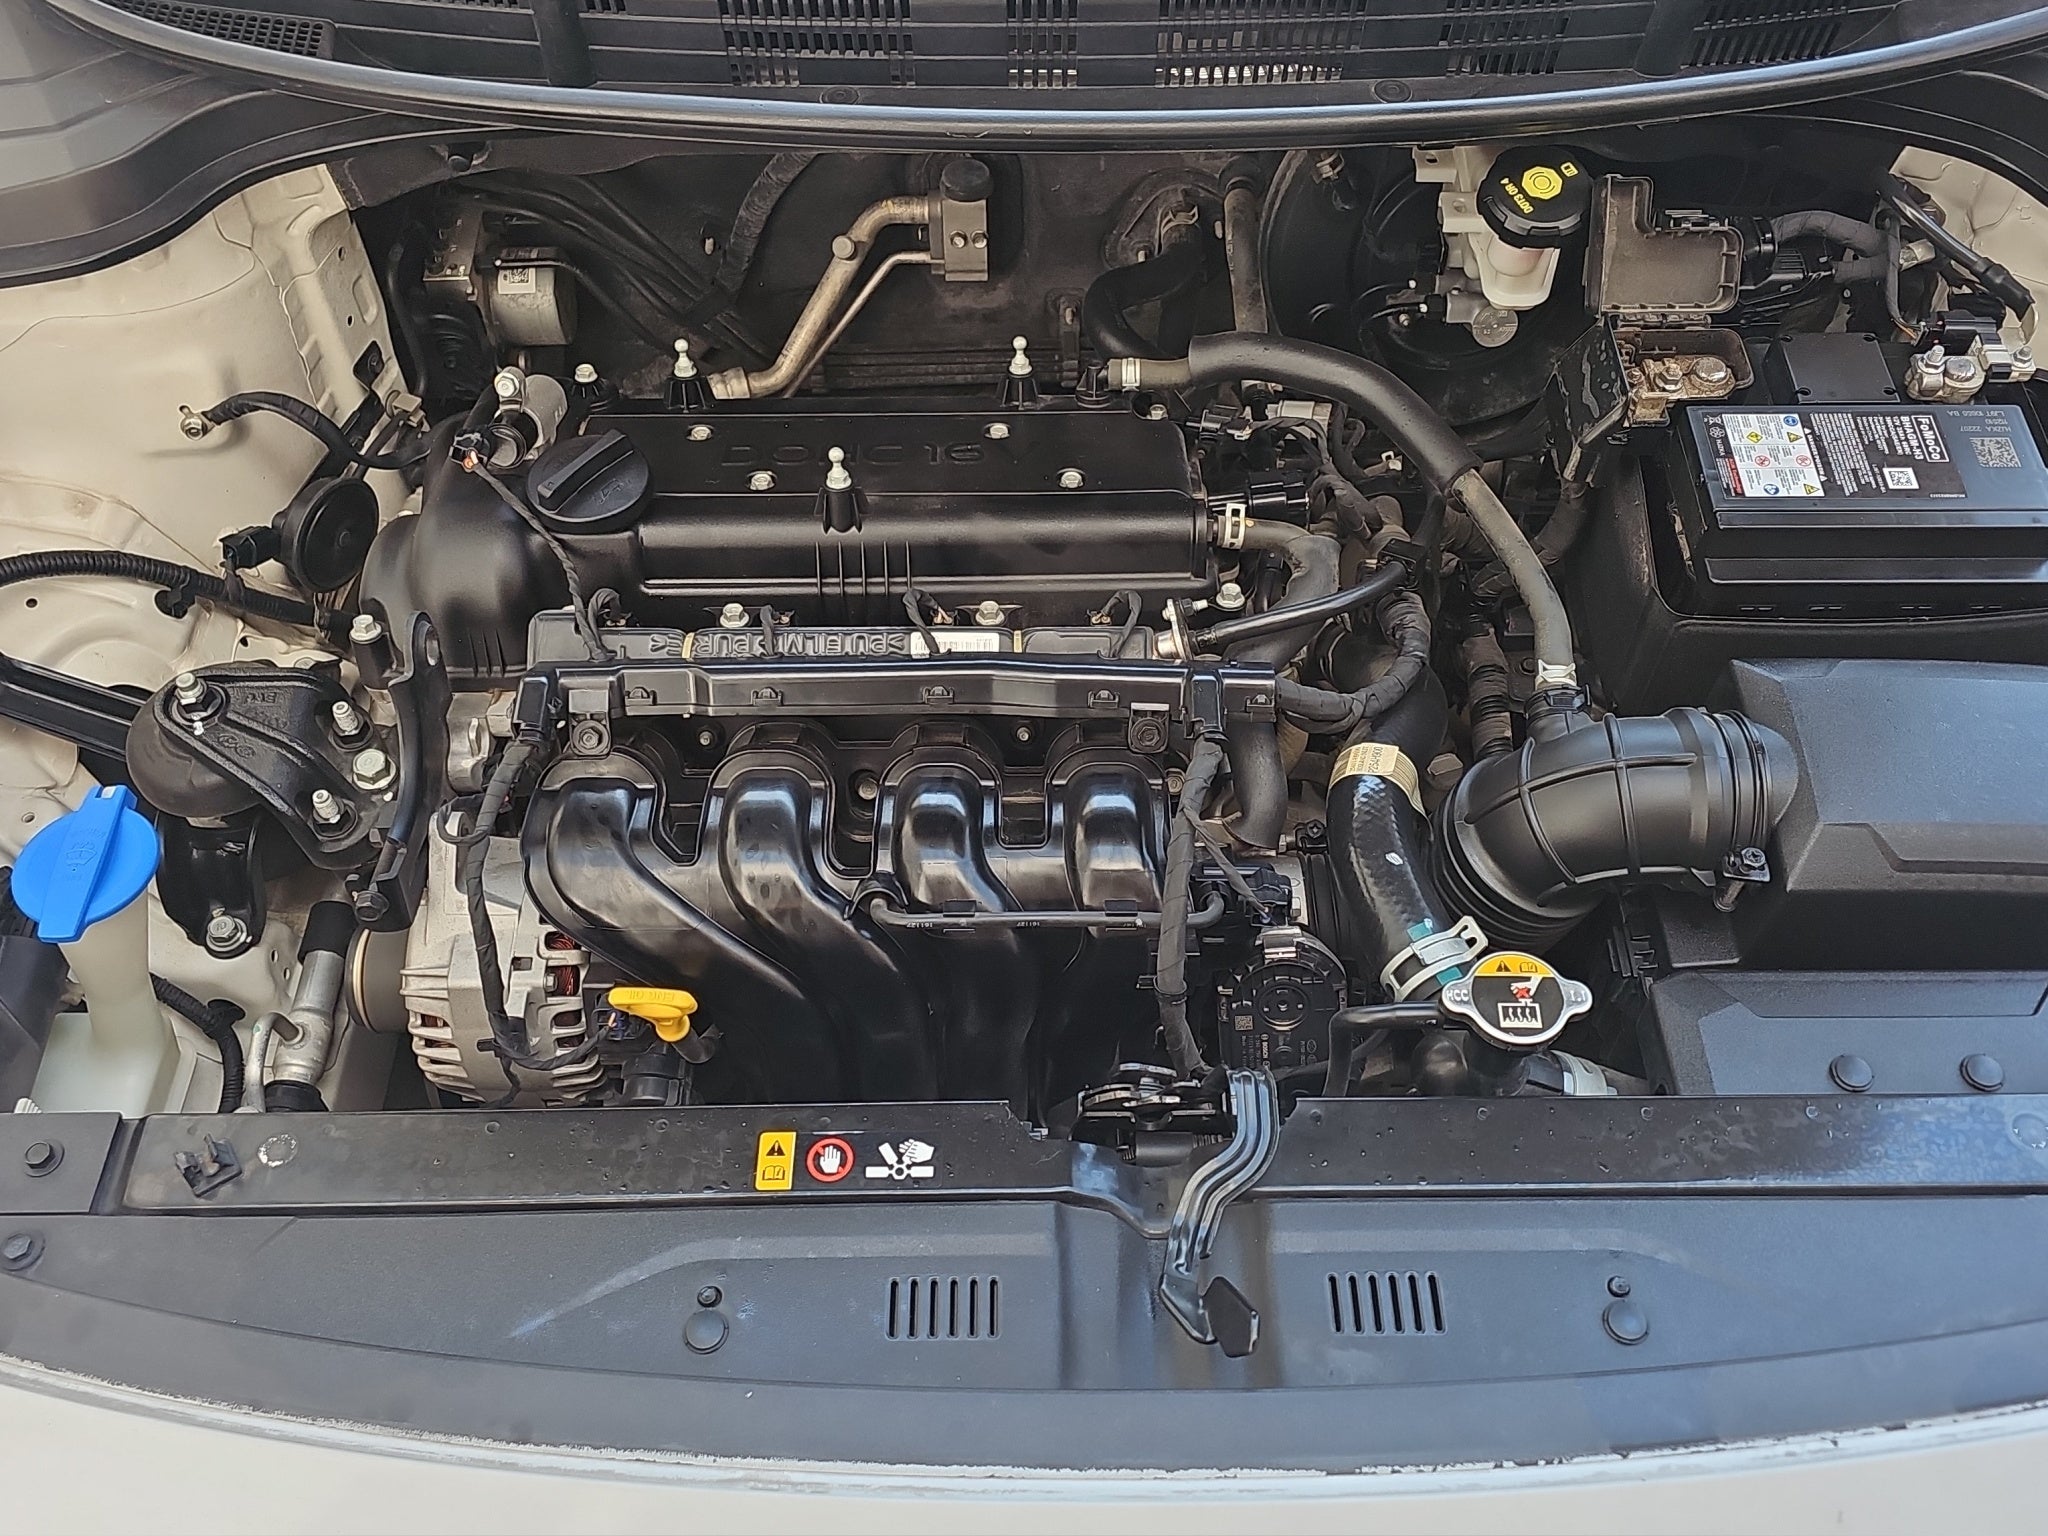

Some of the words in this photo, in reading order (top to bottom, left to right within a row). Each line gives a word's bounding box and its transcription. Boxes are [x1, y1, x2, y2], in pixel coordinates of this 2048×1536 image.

[1499, 177, 1510, 185] 4
[1504, 183, 1519, 195] OR
[1513, 193, 1534, 214] DOT3
[1900, 416, 1924, 460] BHAGM-H3
[1917, 418, 1941, 460] FoMoCo
[1446, 989, 1470, 1002] HCC
